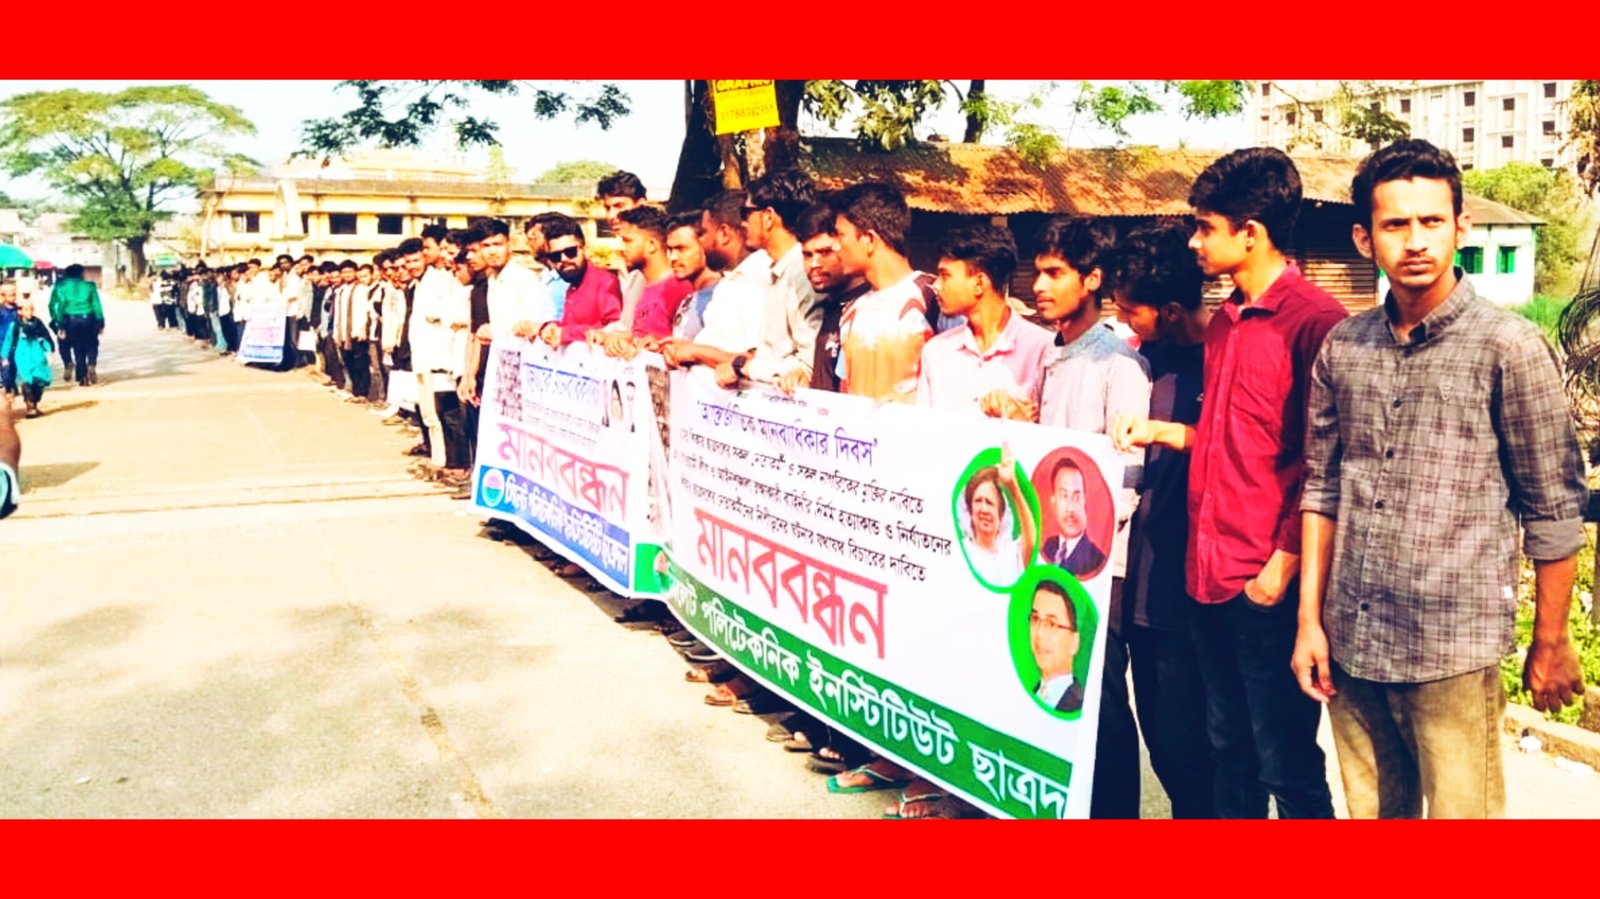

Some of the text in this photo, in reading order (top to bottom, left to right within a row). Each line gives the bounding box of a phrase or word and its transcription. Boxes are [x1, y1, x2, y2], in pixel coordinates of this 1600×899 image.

[758, 417, 829, 455] মানবাধিকার
[495, 423, 631, 523] মানববন্ধন
[890, 488, 926, 514] দাবিতে
[885, 524, 894, 540] ও
[896, 521, 952, 555] নির্যাতনের
[847, 539, 886, 568] বিচারের
[889, 554, 927, 581] দাবিতে
[694, 506, 890, 660] মানববন্ধন
[701, 594, 802, 687] পলিটেকনিক
[806, 653, 959, 767] ইনস্টিটিউট
[968, 741, 1068, 819] ছাত্রদ
